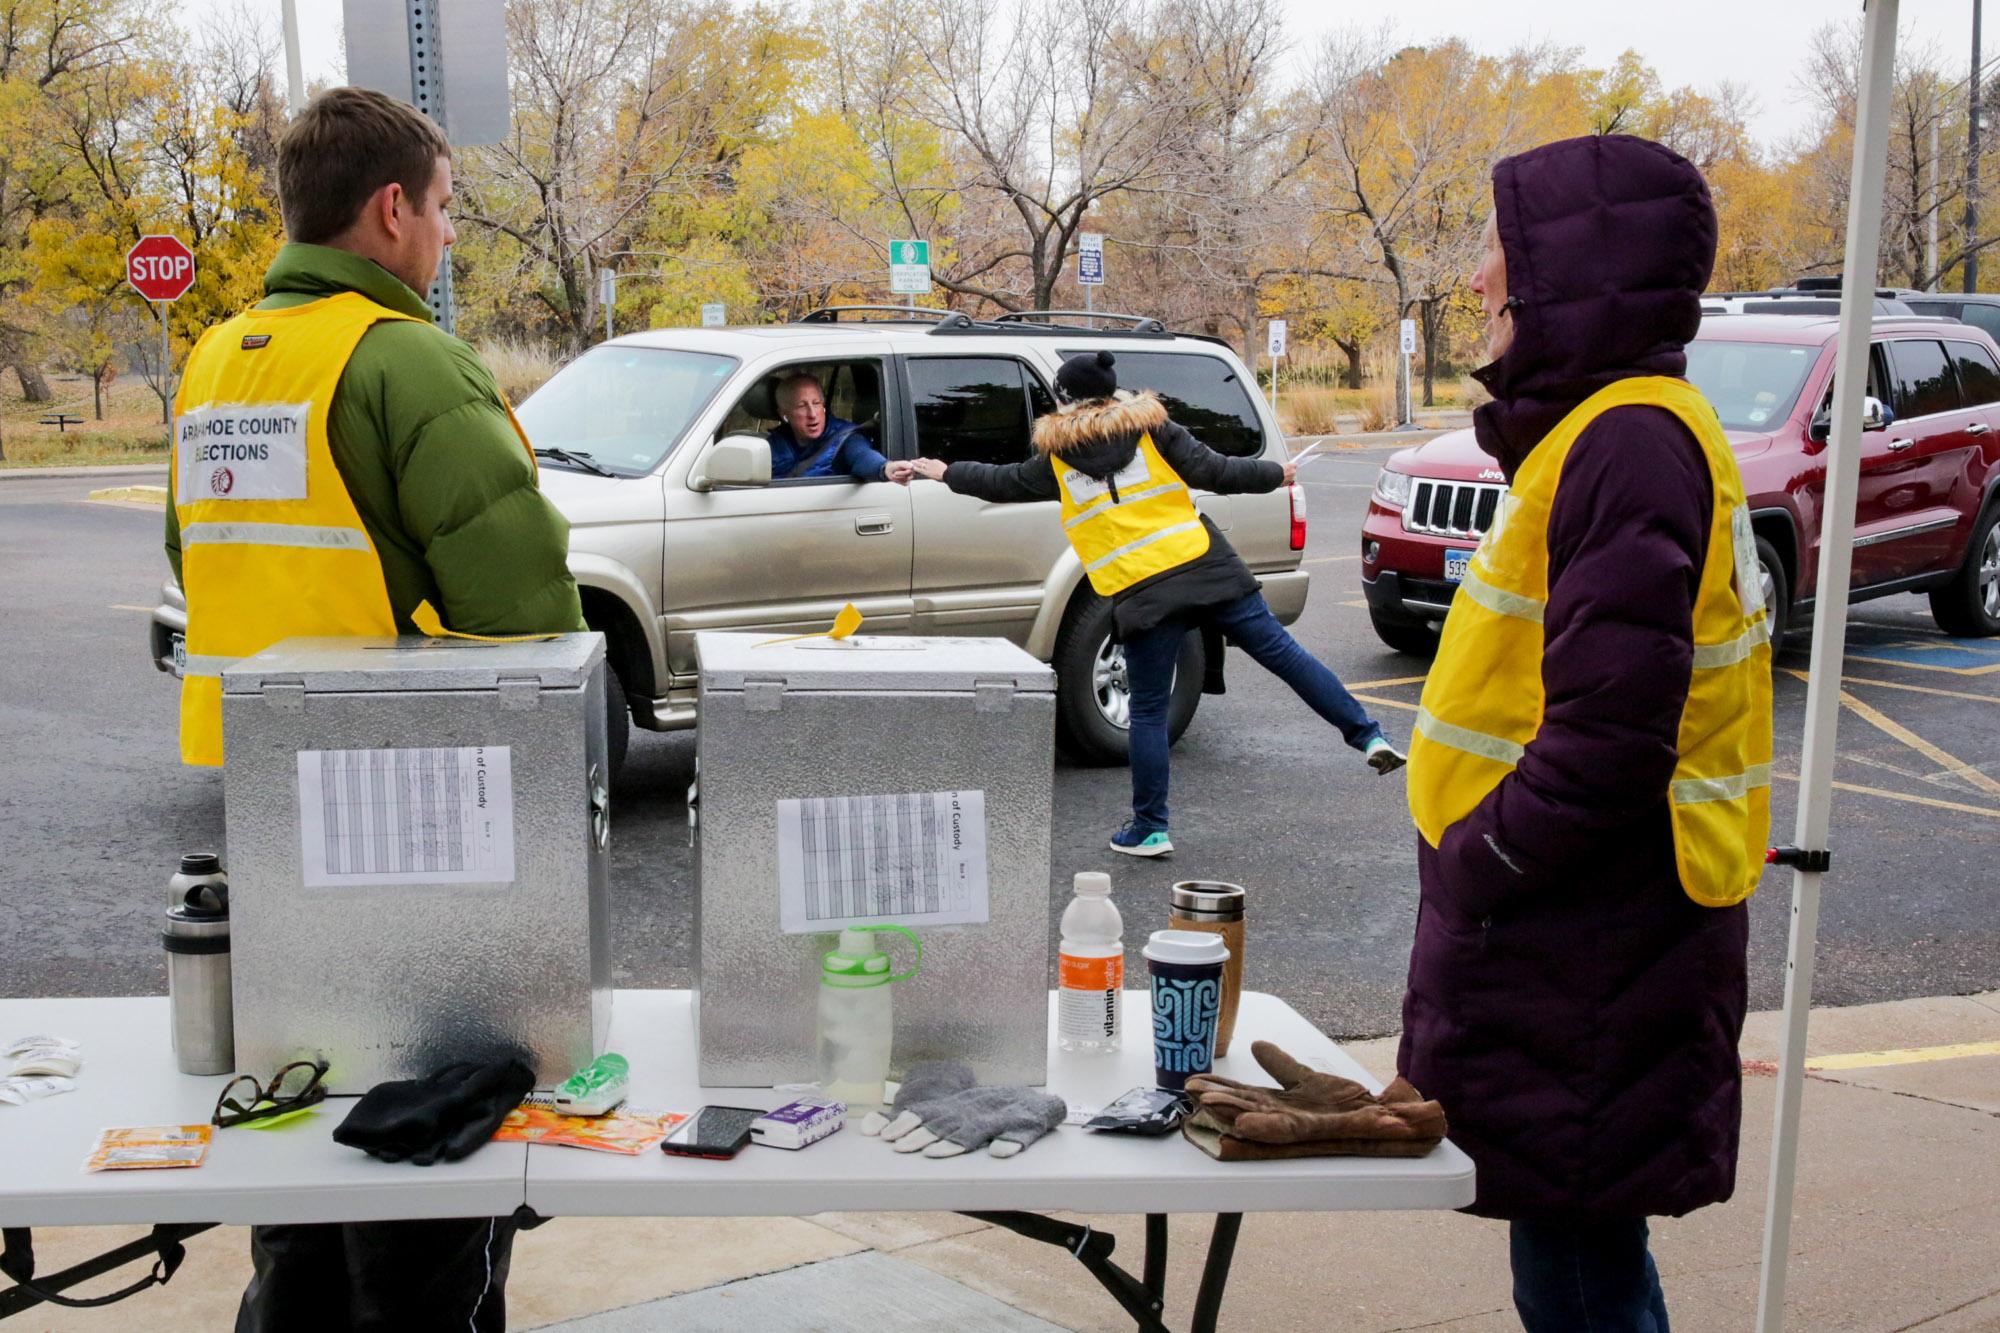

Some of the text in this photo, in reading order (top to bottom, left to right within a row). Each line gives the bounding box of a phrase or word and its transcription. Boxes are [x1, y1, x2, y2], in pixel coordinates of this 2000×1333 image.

[132, 256, 190, 281] STOP
[239, 416, 298, 435] COUNTY
[195, 443, 269, 463] ELECTIONS
[476, 757, 486, 767] of
[476, 769, 487, 809] Custody
[951, 800, 961, 810] of
[952, 812, 963, 851] Custody
[1104, 960, 1115, 1037] vitaminwater
